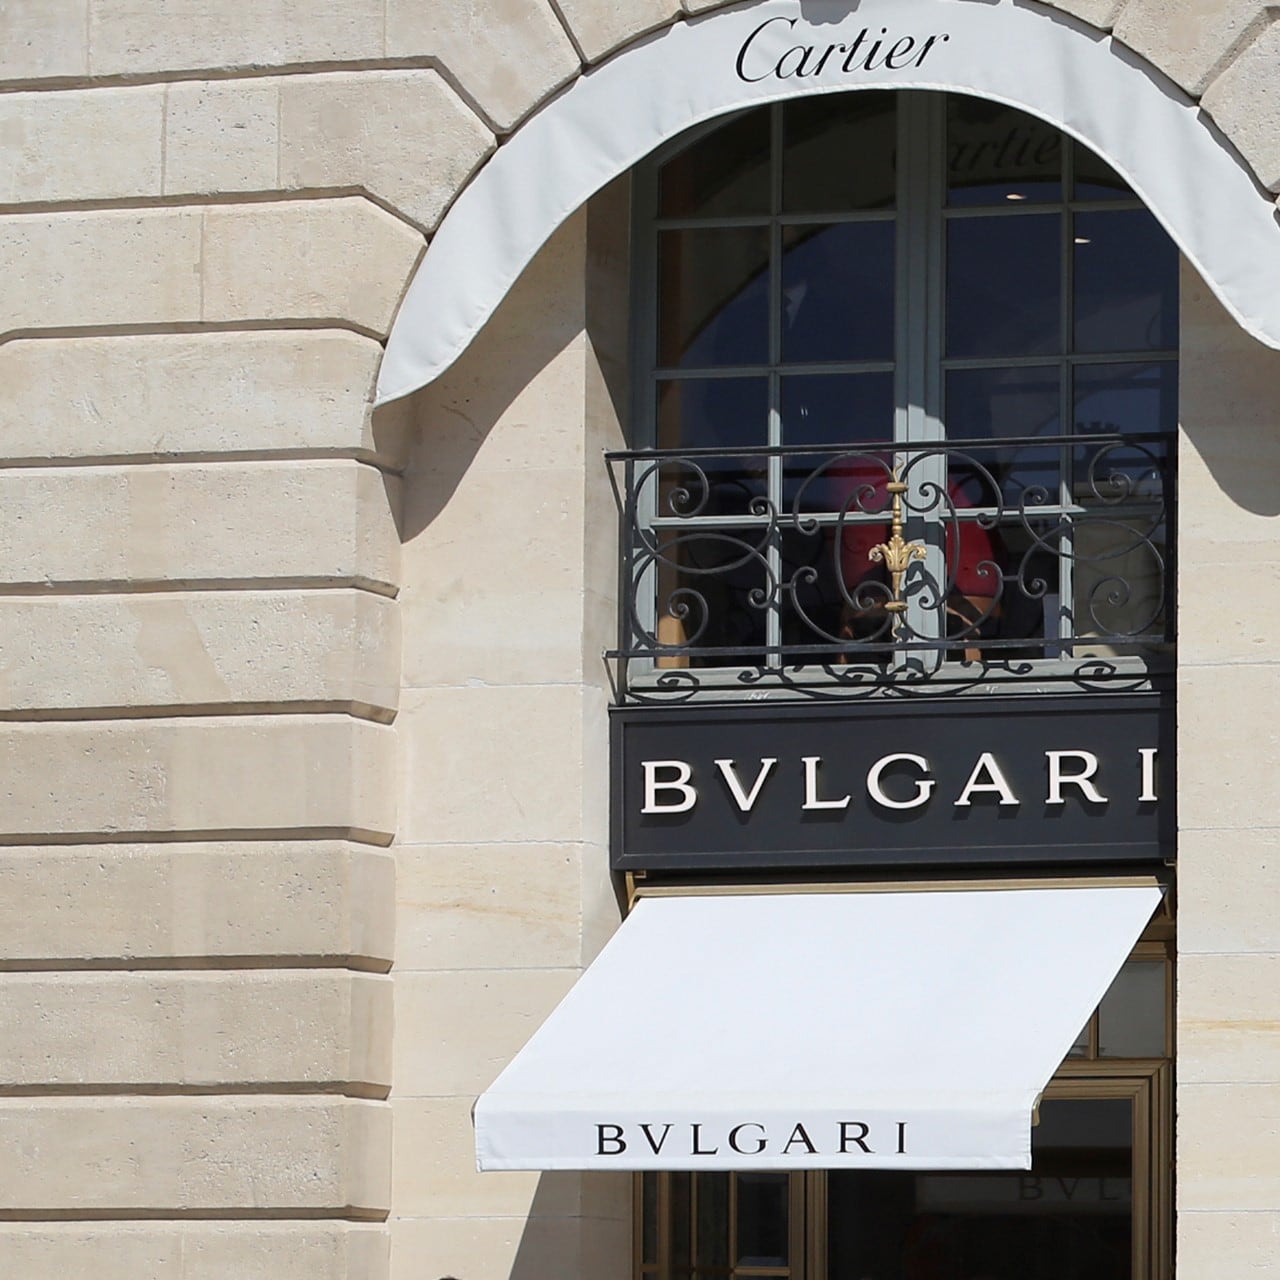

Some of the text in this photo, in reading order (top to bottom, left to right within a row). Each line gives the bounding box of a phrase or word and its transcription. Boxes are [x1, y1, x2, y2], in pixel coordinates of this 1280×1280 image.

[734, 16, 949, 84] Cartier
[641, 747, 1158, 815] BVLGARI
[594, 1122, 908, 1156] BVLGARI
